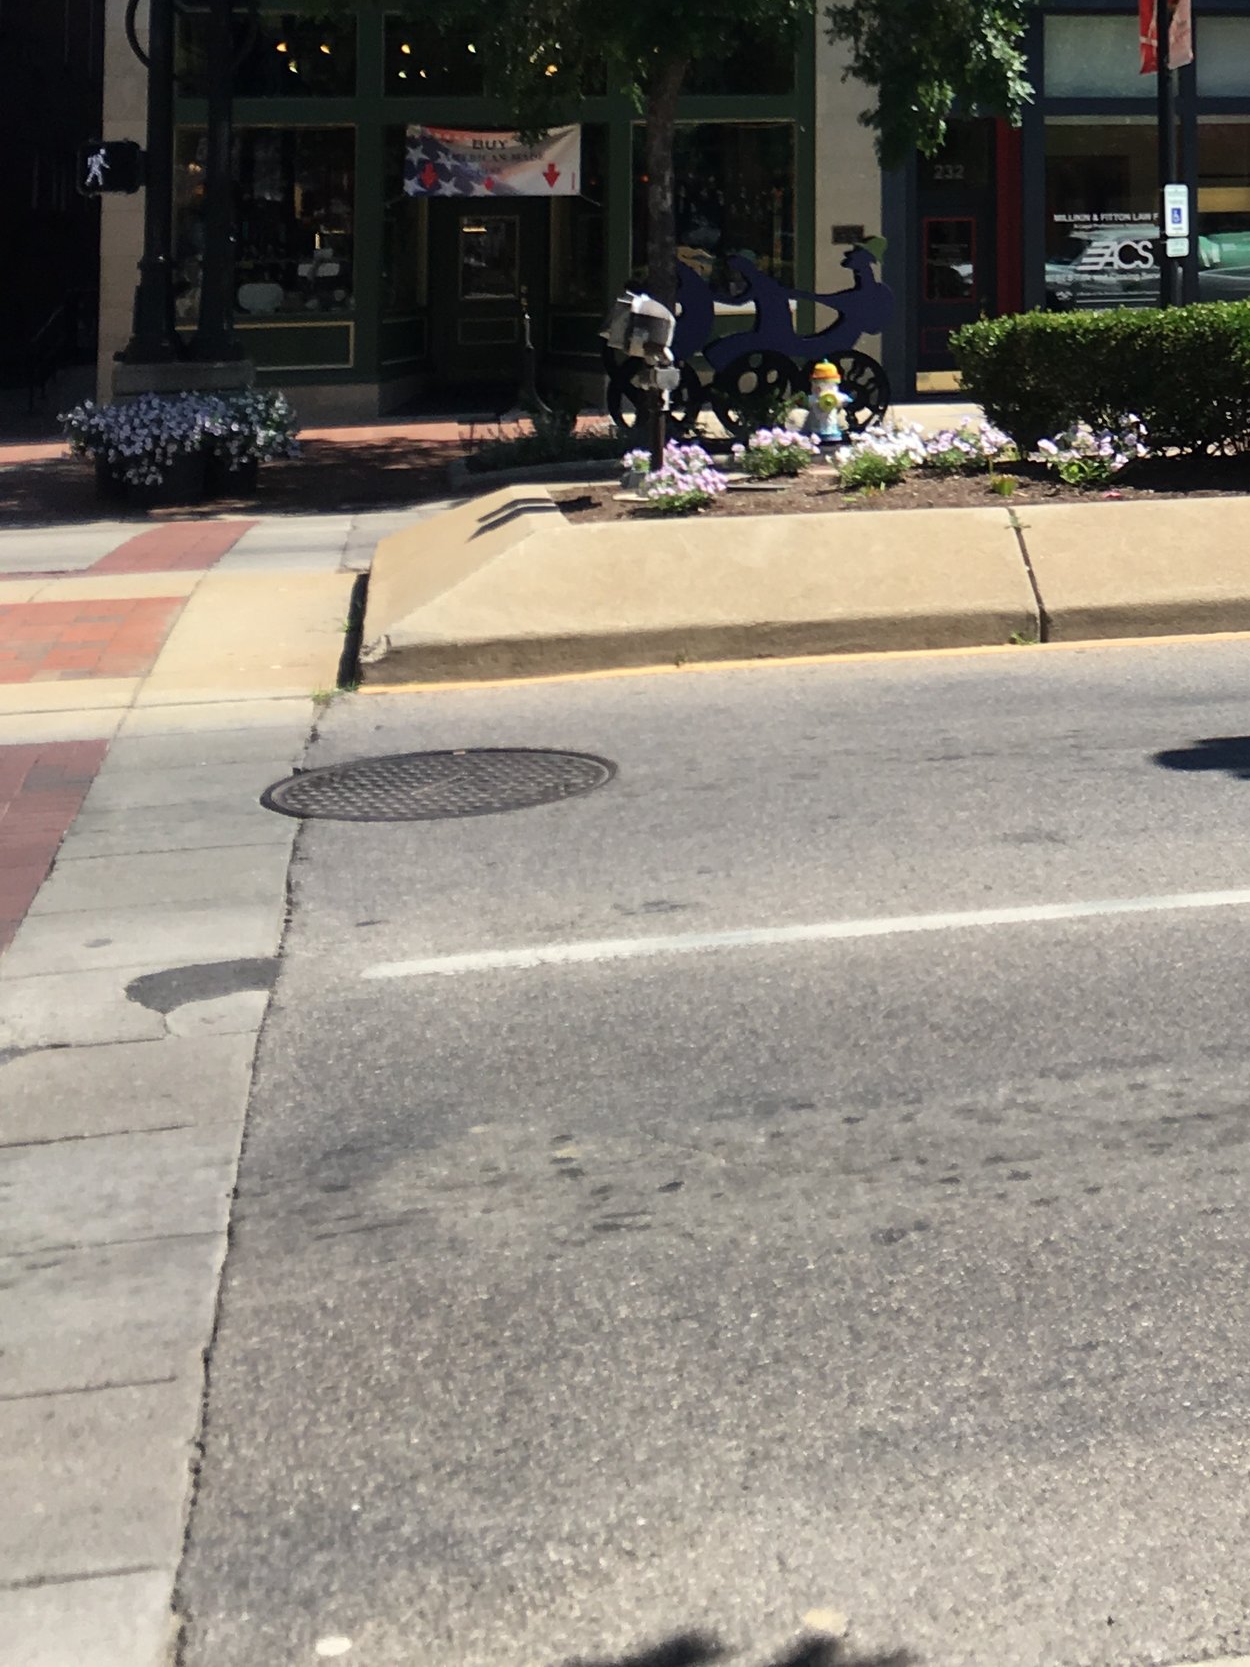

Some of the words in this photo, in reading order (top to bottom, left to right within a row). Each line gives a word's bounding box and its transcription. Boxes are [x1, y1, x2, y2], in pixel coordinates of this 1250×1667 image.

[472, 138, 507, 151] BUY
[933, 164, 965, 180] 232
[1092, 213, 1099, 222] &
[1100, 212, 1132, 222] FITTON
[1133, 212, 1151, 221] LAW
[1077, 239, 1154, 271] ACS
